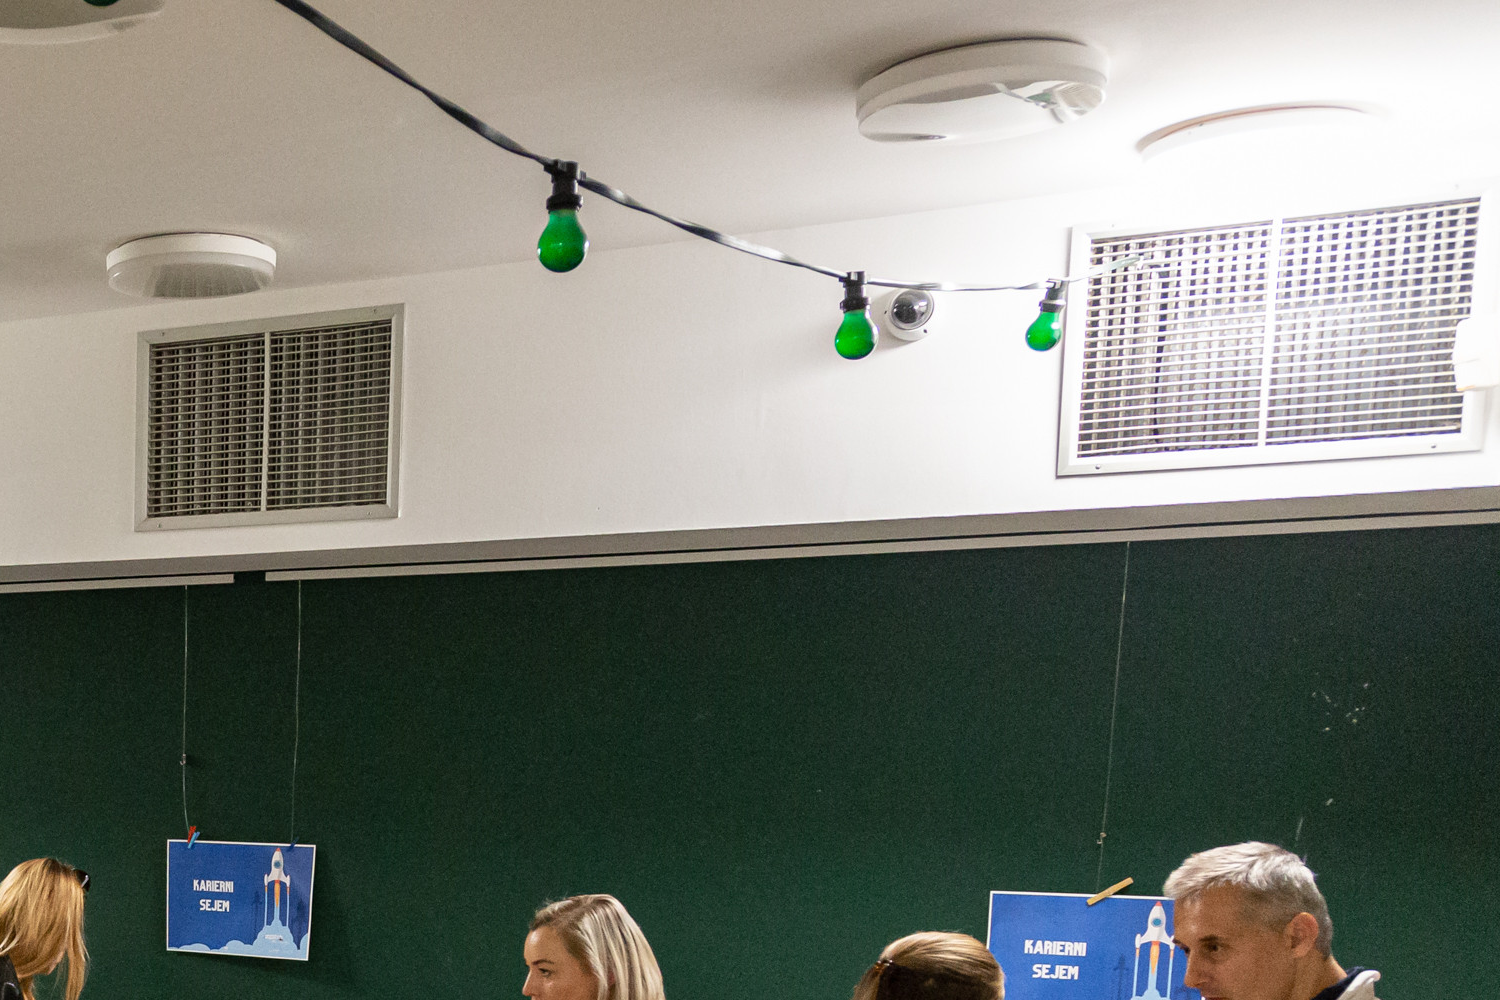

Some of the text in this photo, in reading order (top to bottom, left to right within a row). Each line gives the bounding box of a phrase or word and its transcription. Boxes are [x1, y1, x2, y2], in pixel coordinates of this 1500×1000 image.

[193, 879, 234, 893] KARIERNI
[199, 899, 230, 912] SEJEM
[1024, 939, 1087, 957] KARIERNI
[1032, 963, 1079, 980] SEJEM
